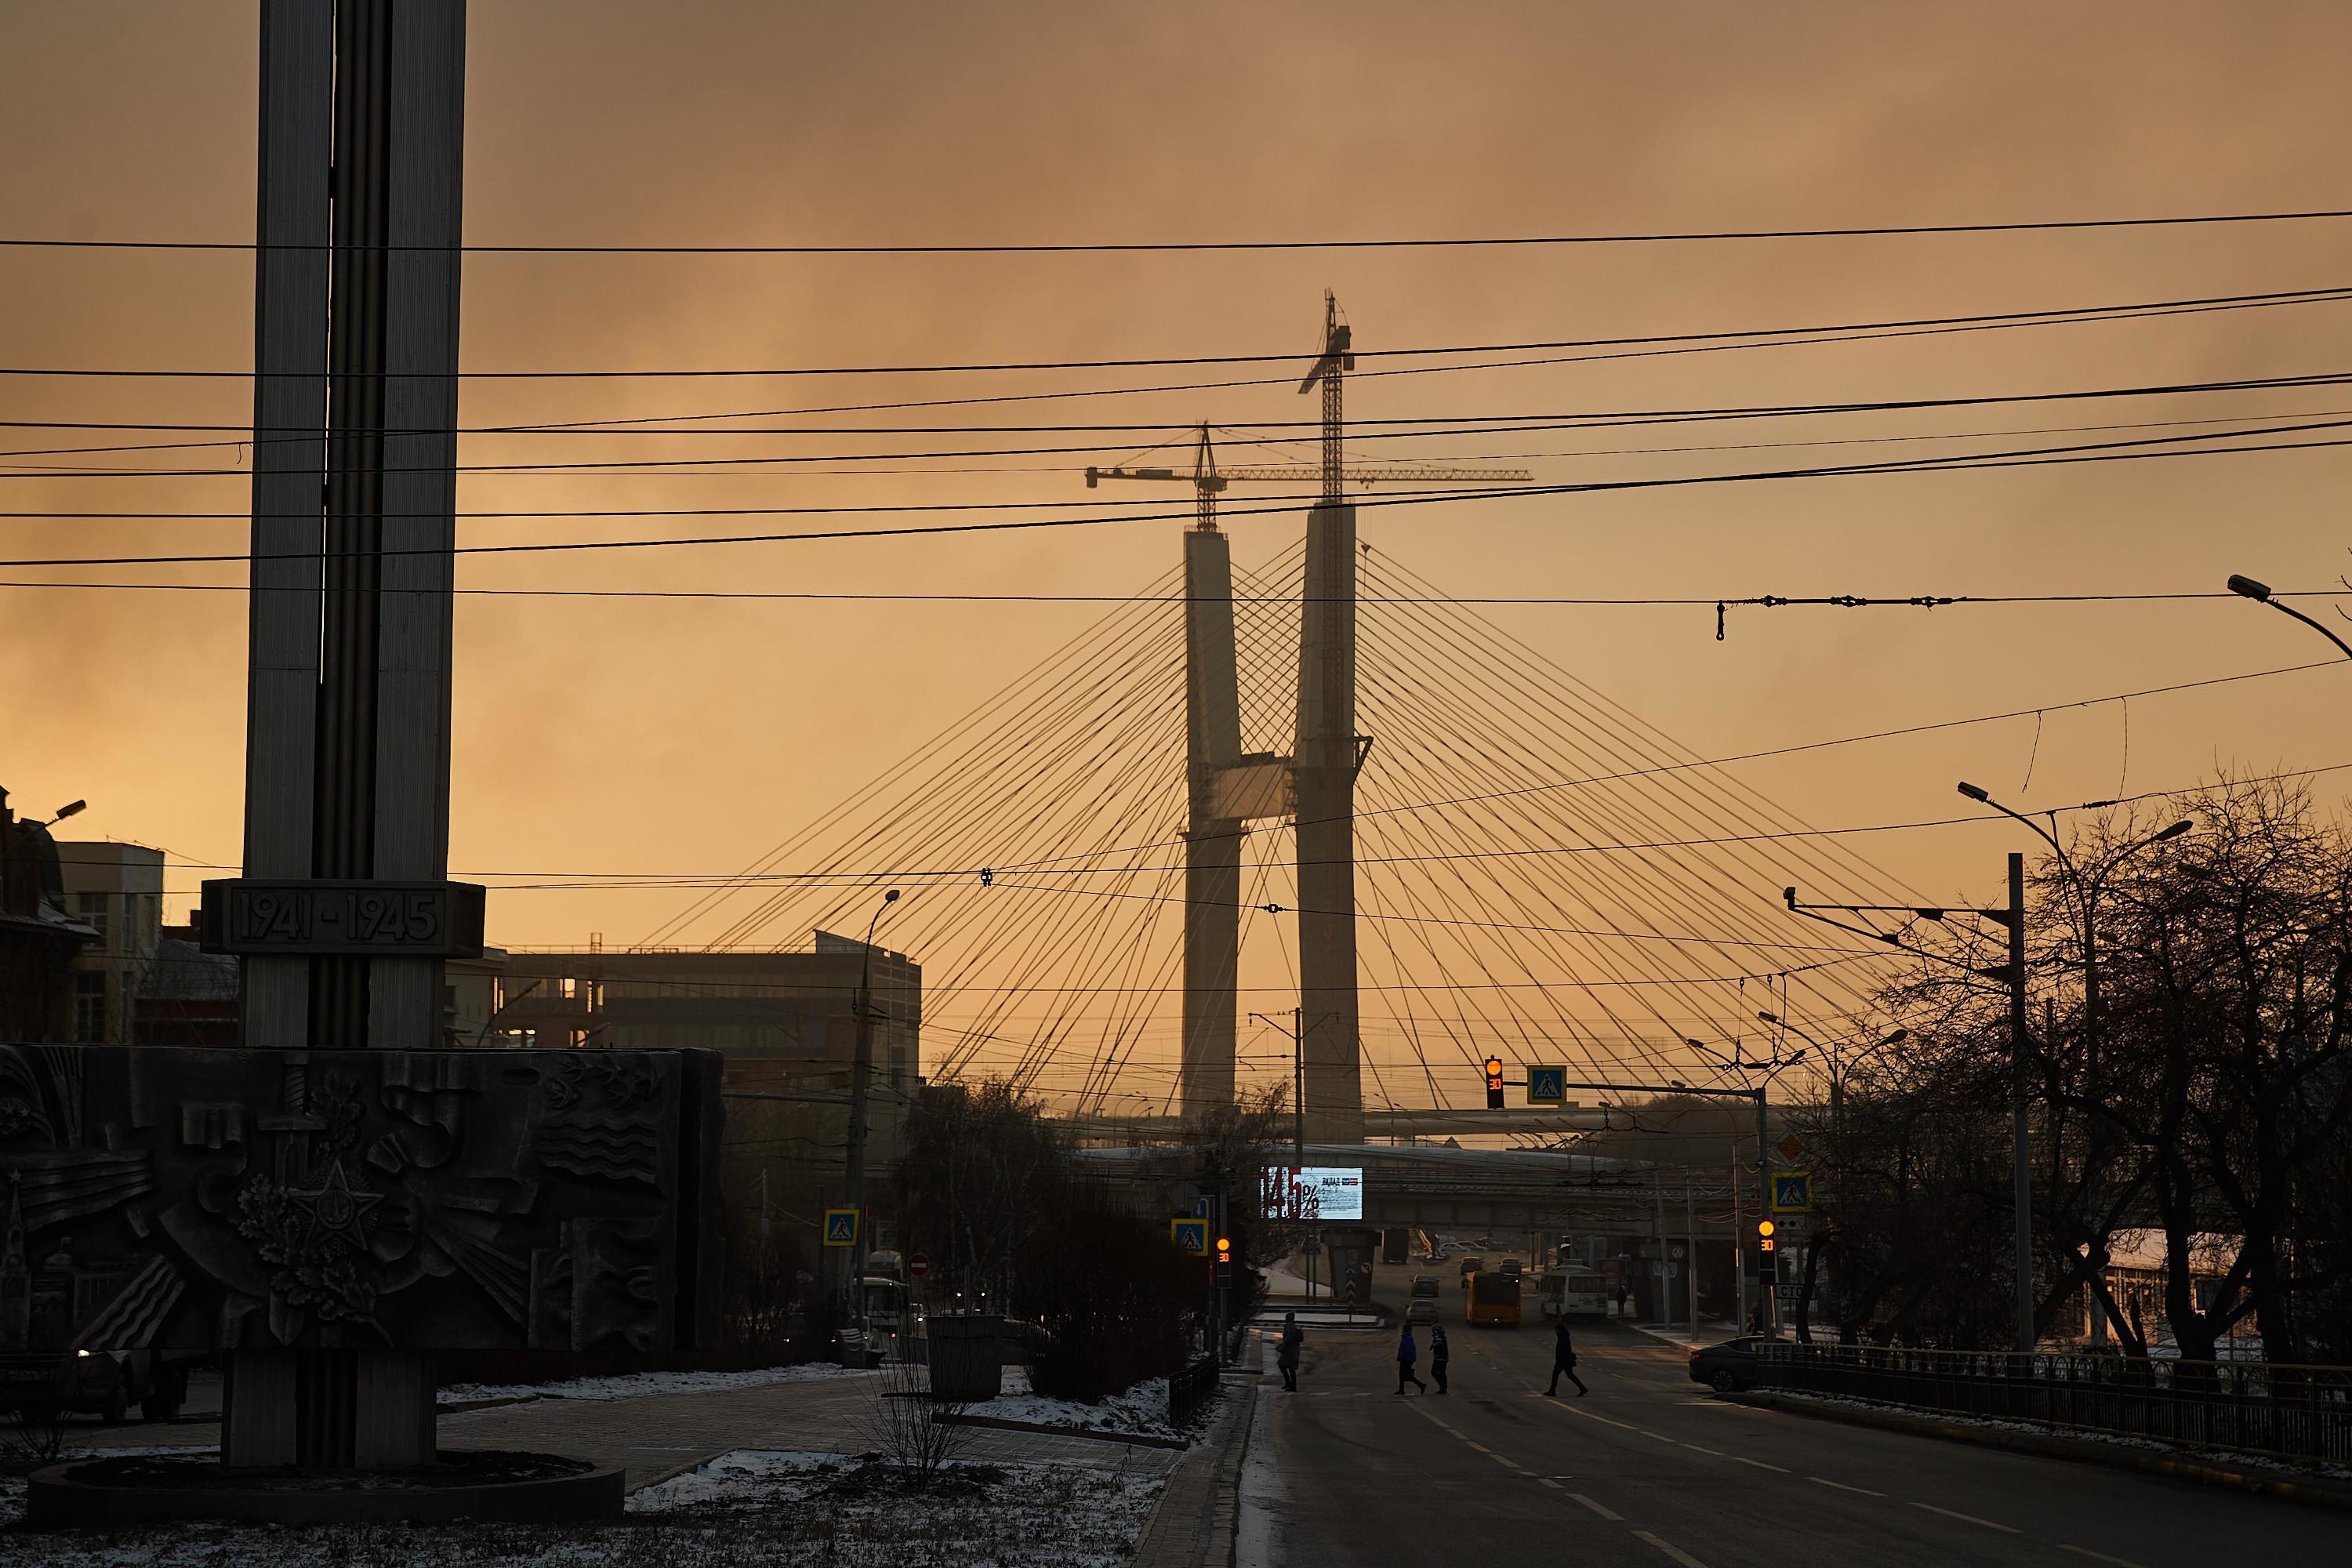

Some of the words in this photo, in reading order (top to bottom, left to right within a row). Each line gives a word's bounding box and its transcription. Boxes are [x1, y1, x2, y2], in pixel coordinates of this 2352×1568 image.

[239, 892, 313, 939] 1941
[347, 893, 437, 941] 1945
[1489, 1078, 1502, 1090] 30
[1761, 1240, 1774, 1251] 30
[1780, 1287, 1804, 1297] СТО
